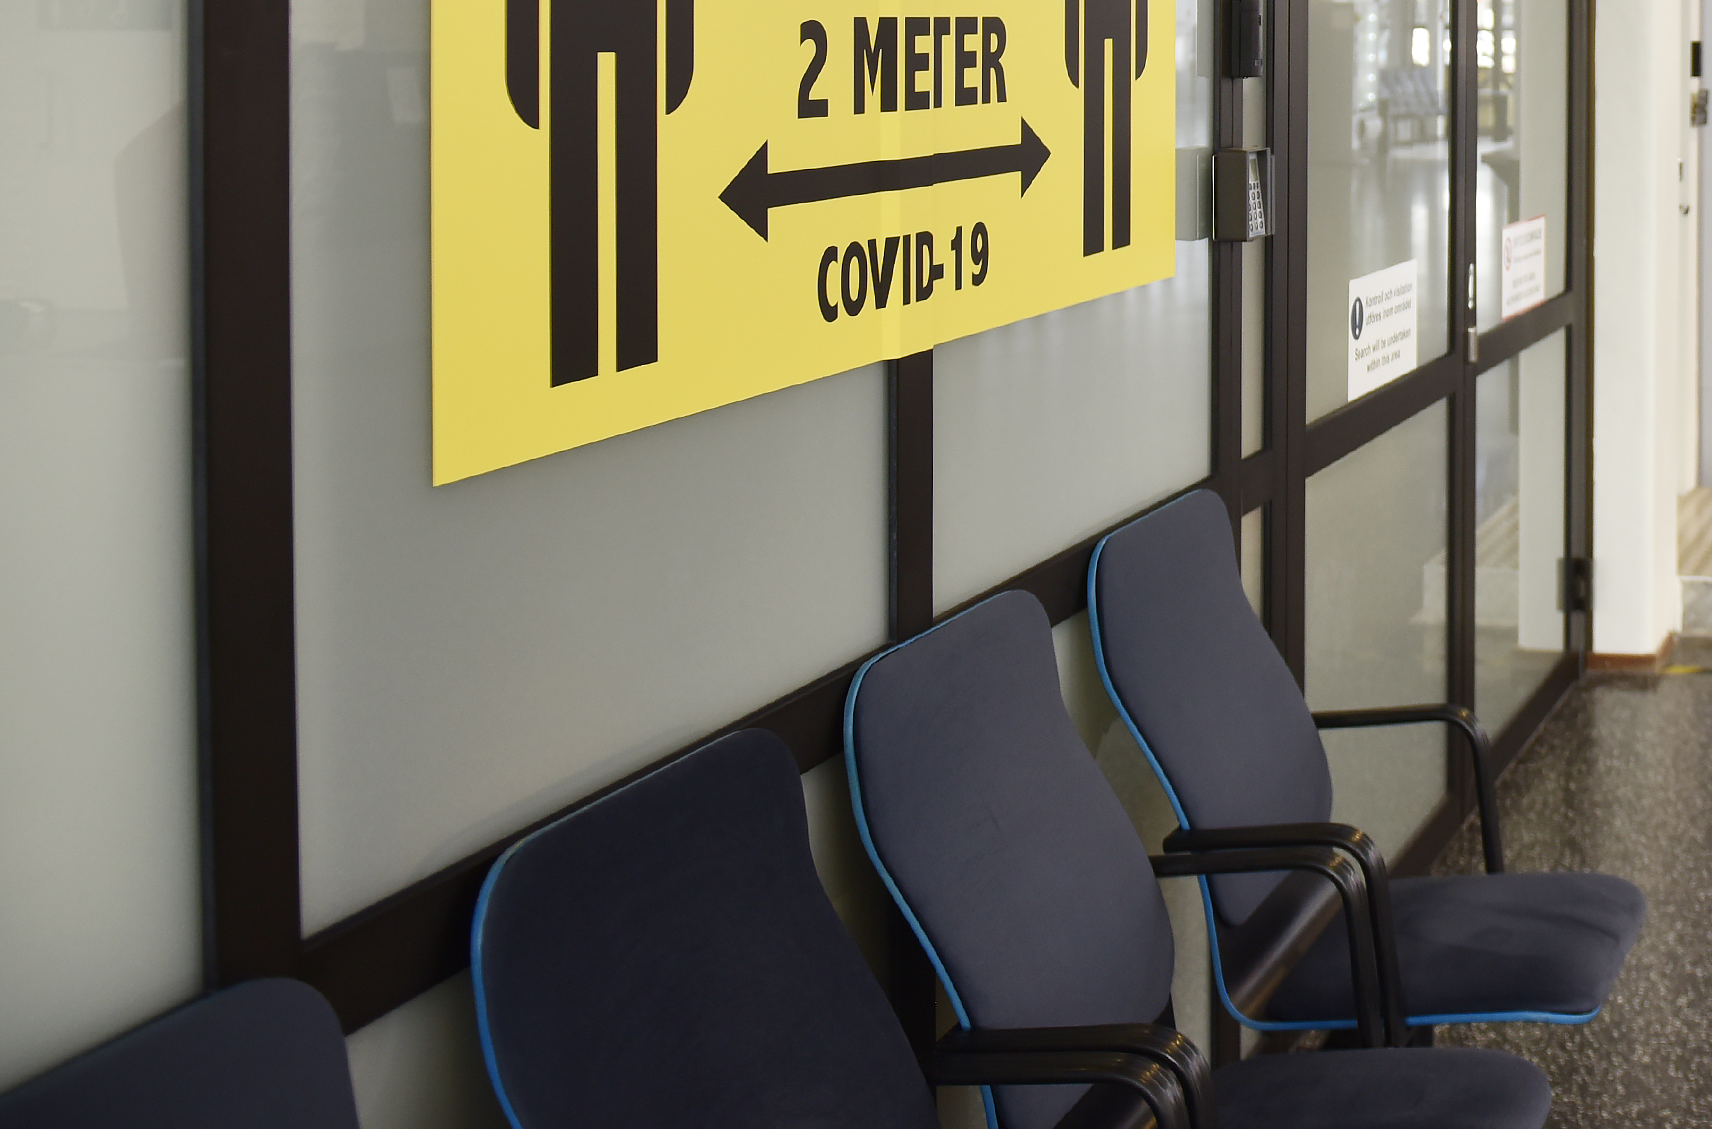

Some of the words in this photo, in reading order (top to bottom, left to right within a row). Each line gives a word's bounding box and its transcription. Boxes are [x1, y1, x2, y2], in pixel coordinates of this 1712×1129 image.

[797, 19, 829, 119] 2
[853, 16, 1008, 116] METER
[817, 221, 989, 323] COVID-19
[1365, 290, 1384, 307] Kontroll
[1384, 288, 1393, 302] och
[1394, 283, 1413, 297] visitation
[1365, 311, 1382, 326] utföres
[1383, 307, 1394, 320] inom
[1354, 343, 1371, 361] Search
[1372, 338, 1380, 352] will
[1381, 337, 1387, 349] be
[1387, 327, 1411, 347] undertaken
[1366, 356, 1381, 372] within
[1381, 354, 1390, 366] this
[1391, 349, 1401, 361] area
